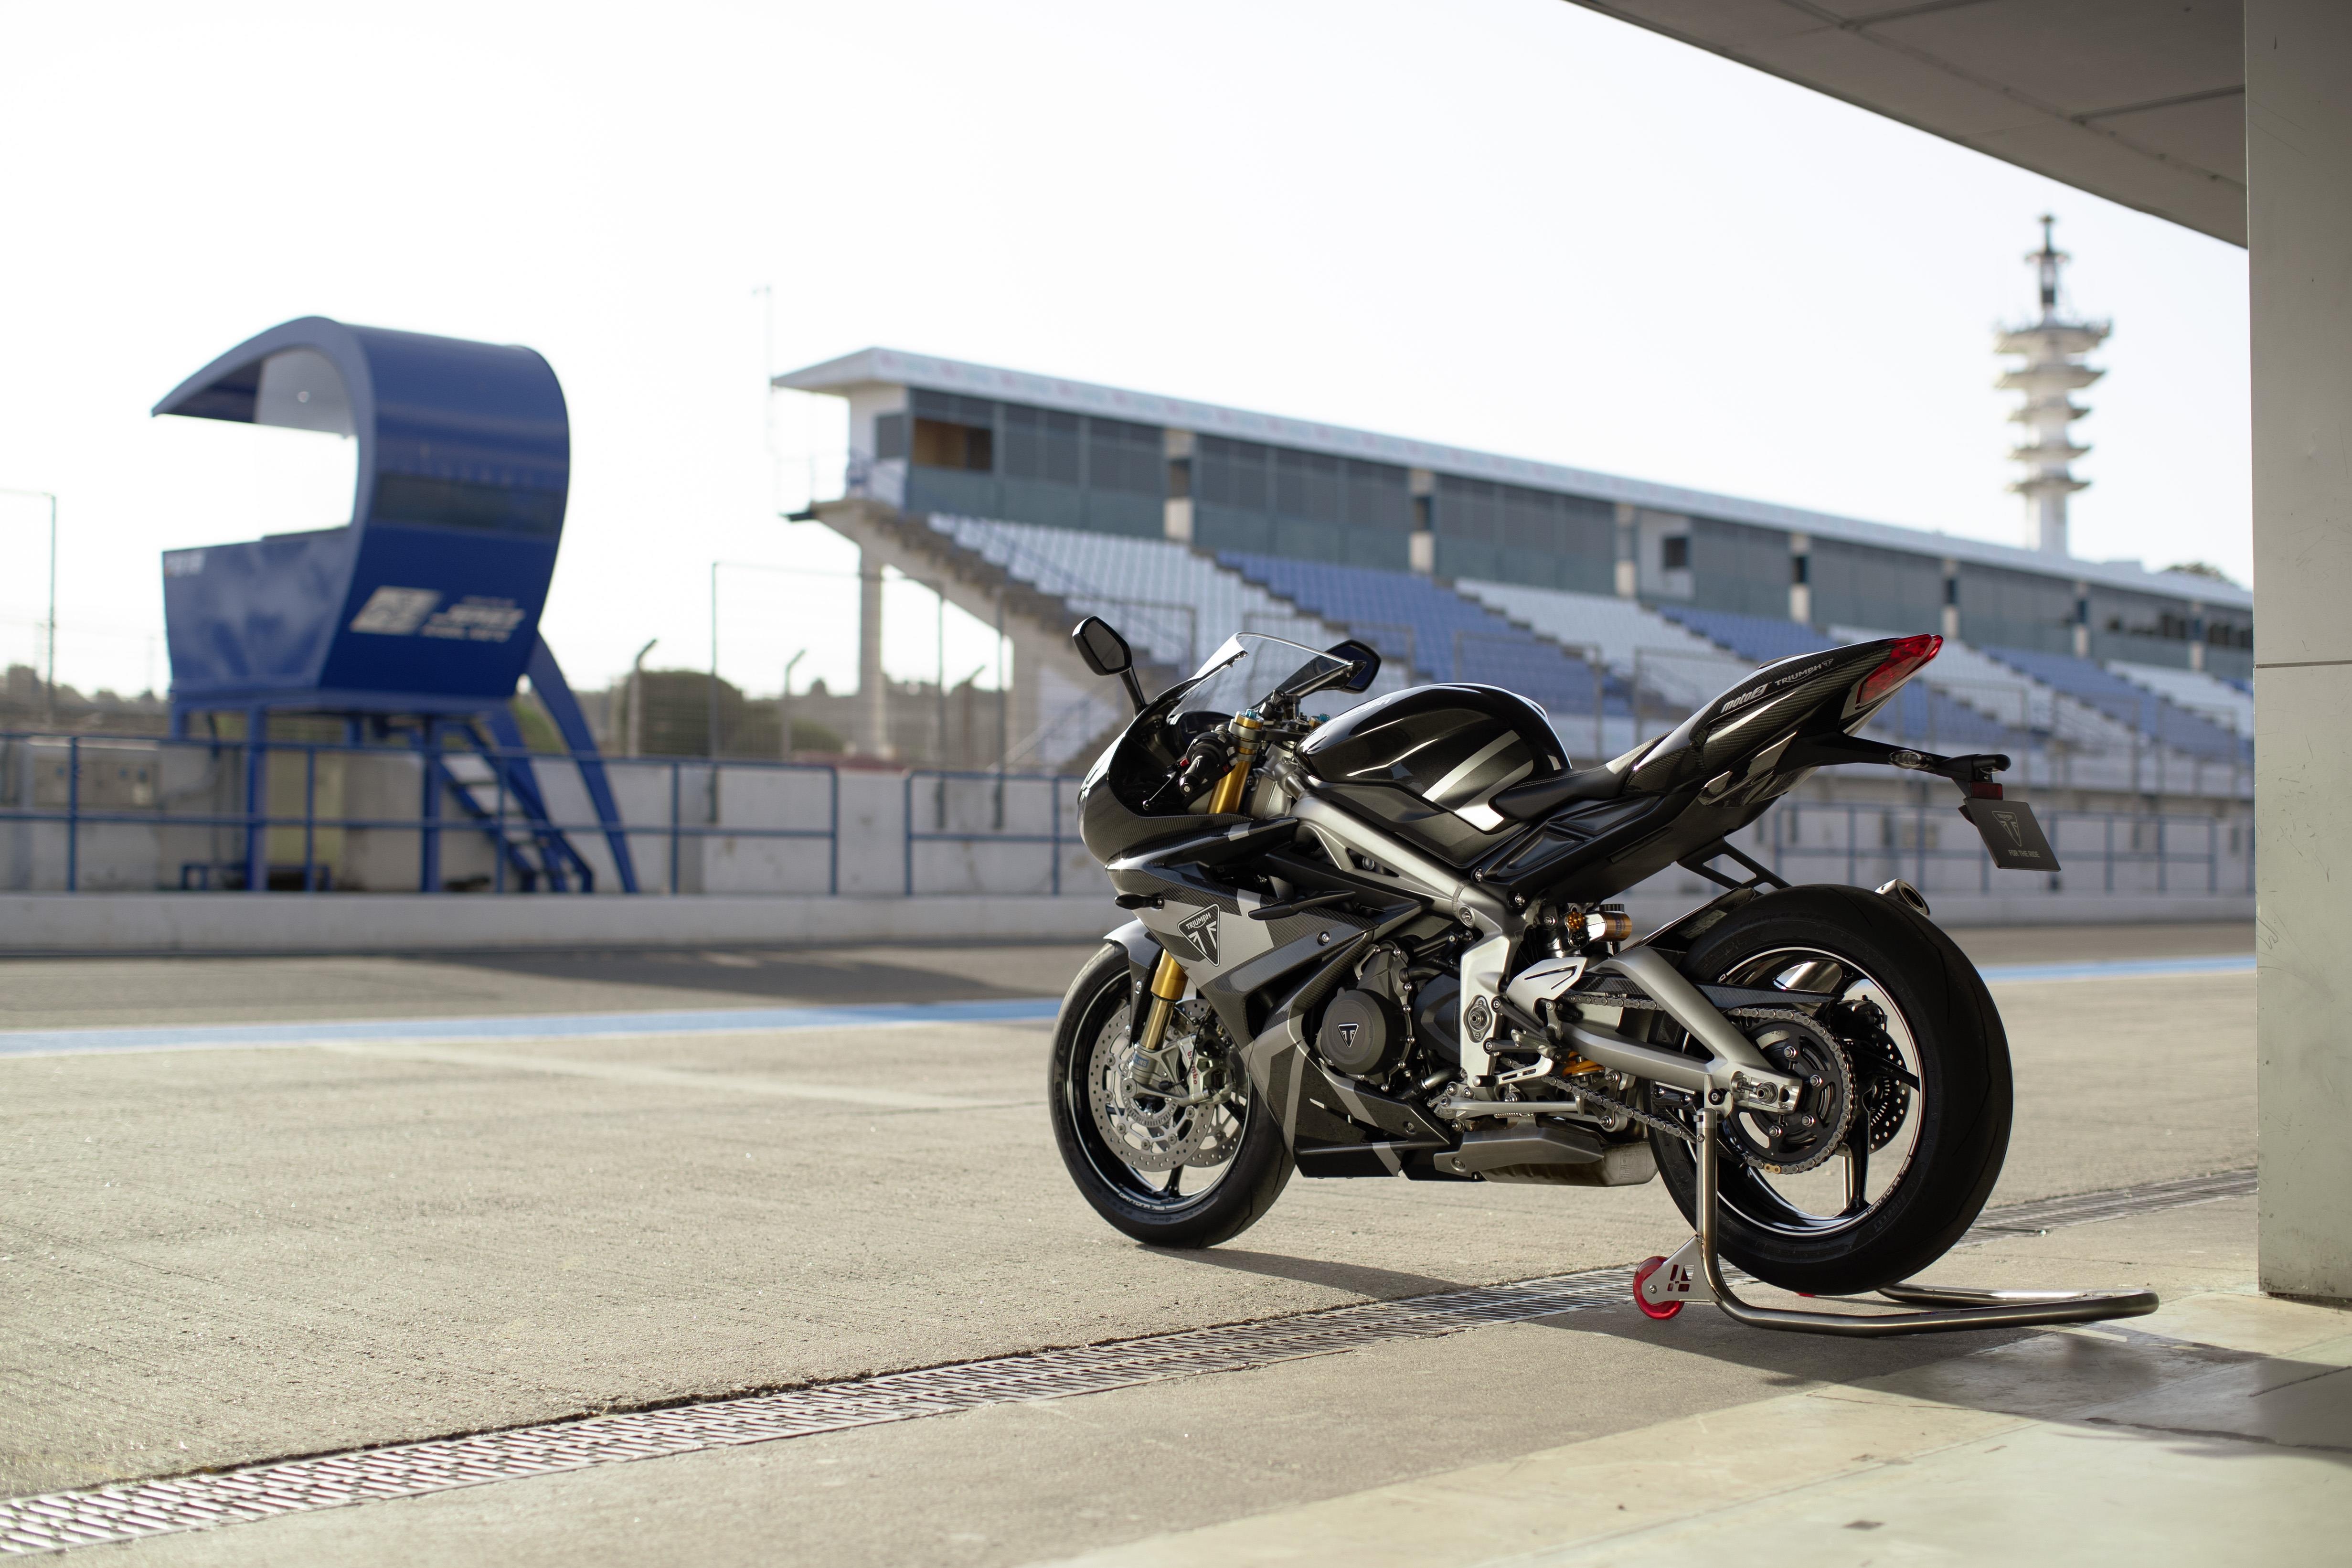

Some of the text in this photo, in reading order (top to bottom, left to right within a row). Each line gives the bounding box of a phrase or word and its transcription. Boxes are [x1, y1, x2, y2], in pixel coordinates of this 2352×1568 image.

[1775, 664, 1822, 686] TRIUMPH
[1185, 912, 1212, 930] TRIUMPH
[1868, 1156, 1911, 1214] DAYTONA 765
